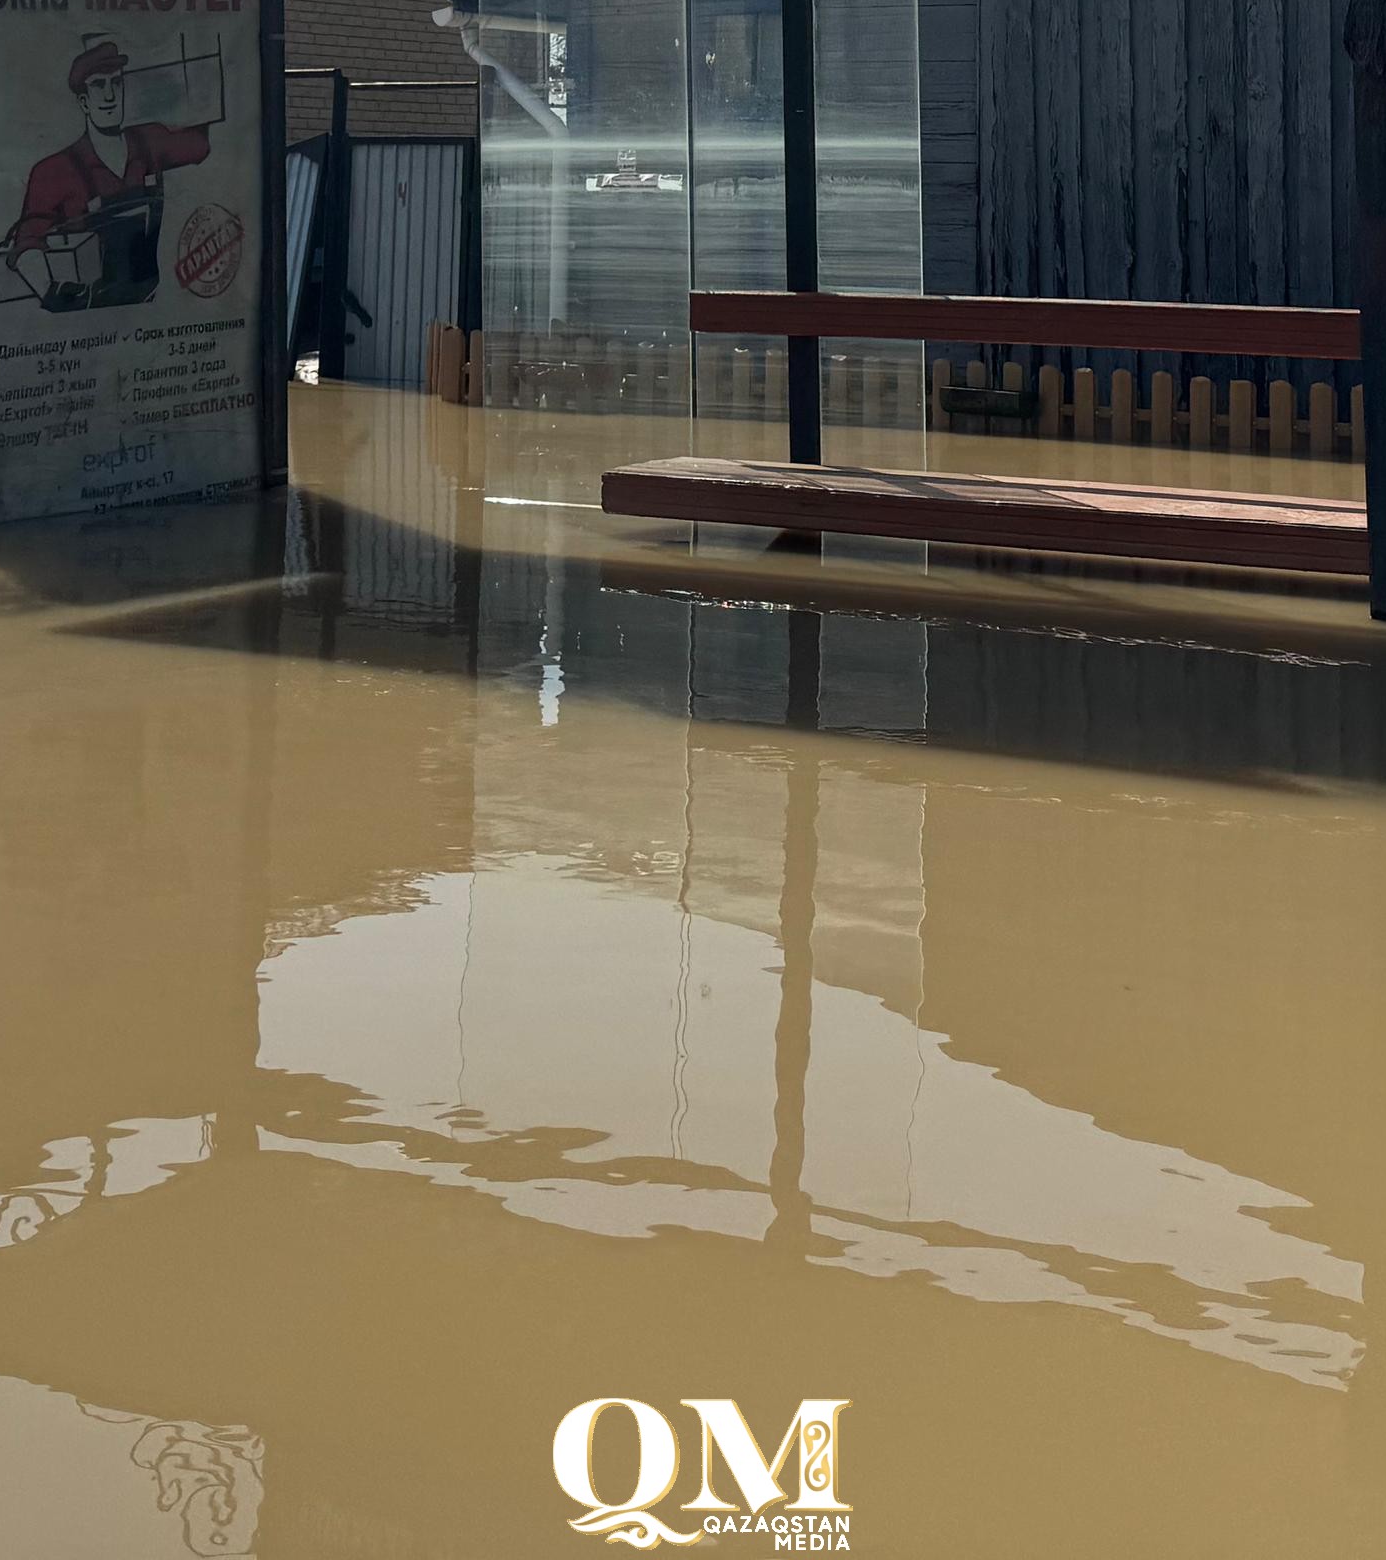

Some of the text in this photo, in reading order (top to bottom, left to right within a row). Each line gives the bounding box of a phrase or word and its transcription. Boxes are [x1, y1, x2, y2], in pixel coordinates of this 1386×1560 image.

[134, 318, 245, 343] Срок изготовления
[168, 338, 217, 356] 3-5 дней
[37, 360, 56, 375] 3-5
[133, 359, 226, 383] Гарантия 3 года
[57, 379, 65, 393] 3
[133, 384, 188, 403] Профиль
[133, 392, 255, 425] Замер БЕСПЛАТНО
